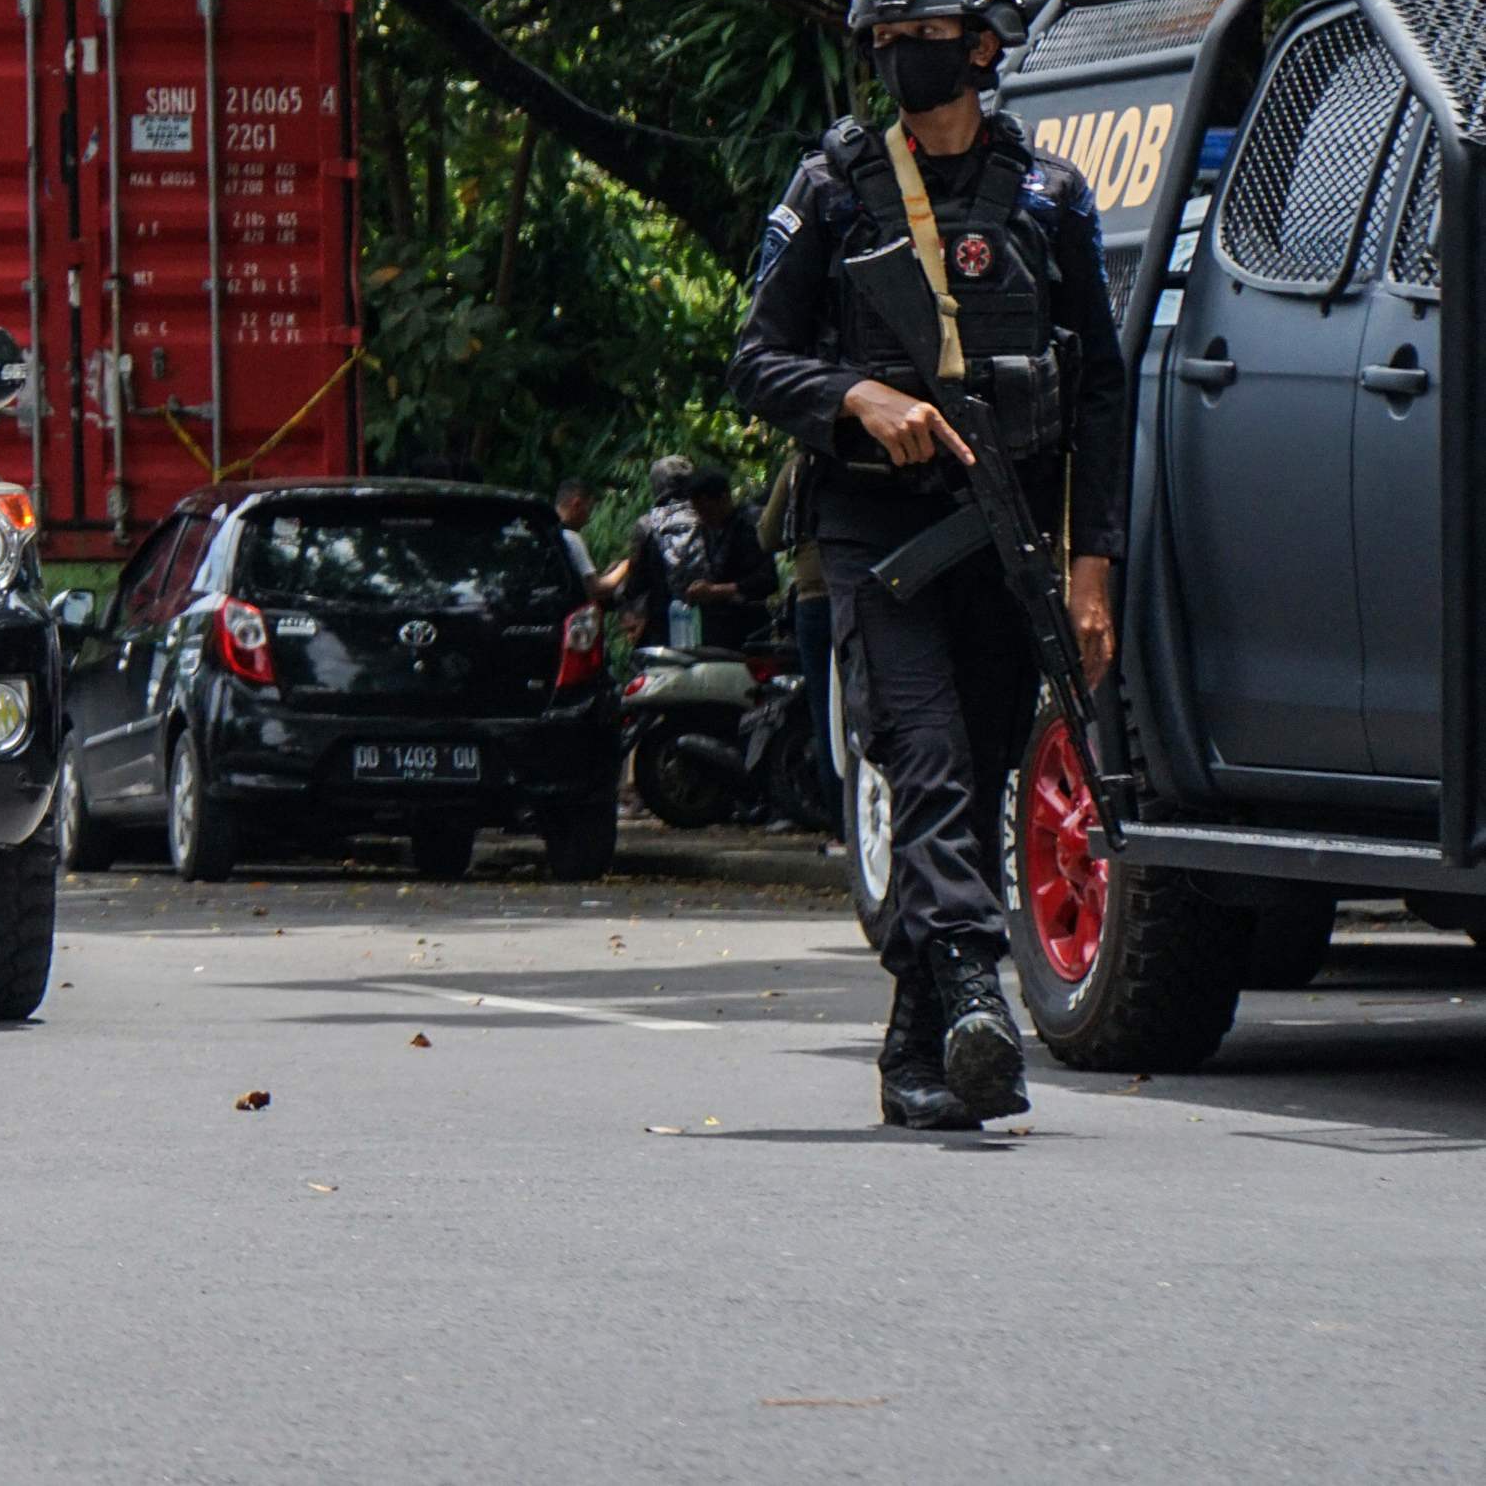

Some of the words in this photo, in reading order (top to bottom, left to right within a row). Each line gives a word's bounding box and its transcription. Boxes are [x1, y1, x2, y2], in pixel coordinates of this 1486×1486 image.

[145, 86, 196, 114] SBNU
[226, 86, 302, 114] 216065
[322, 87, 339, 113] 4
[227, 123, 277, 151] 22G1
[394, 745, 437, 768] 1403
